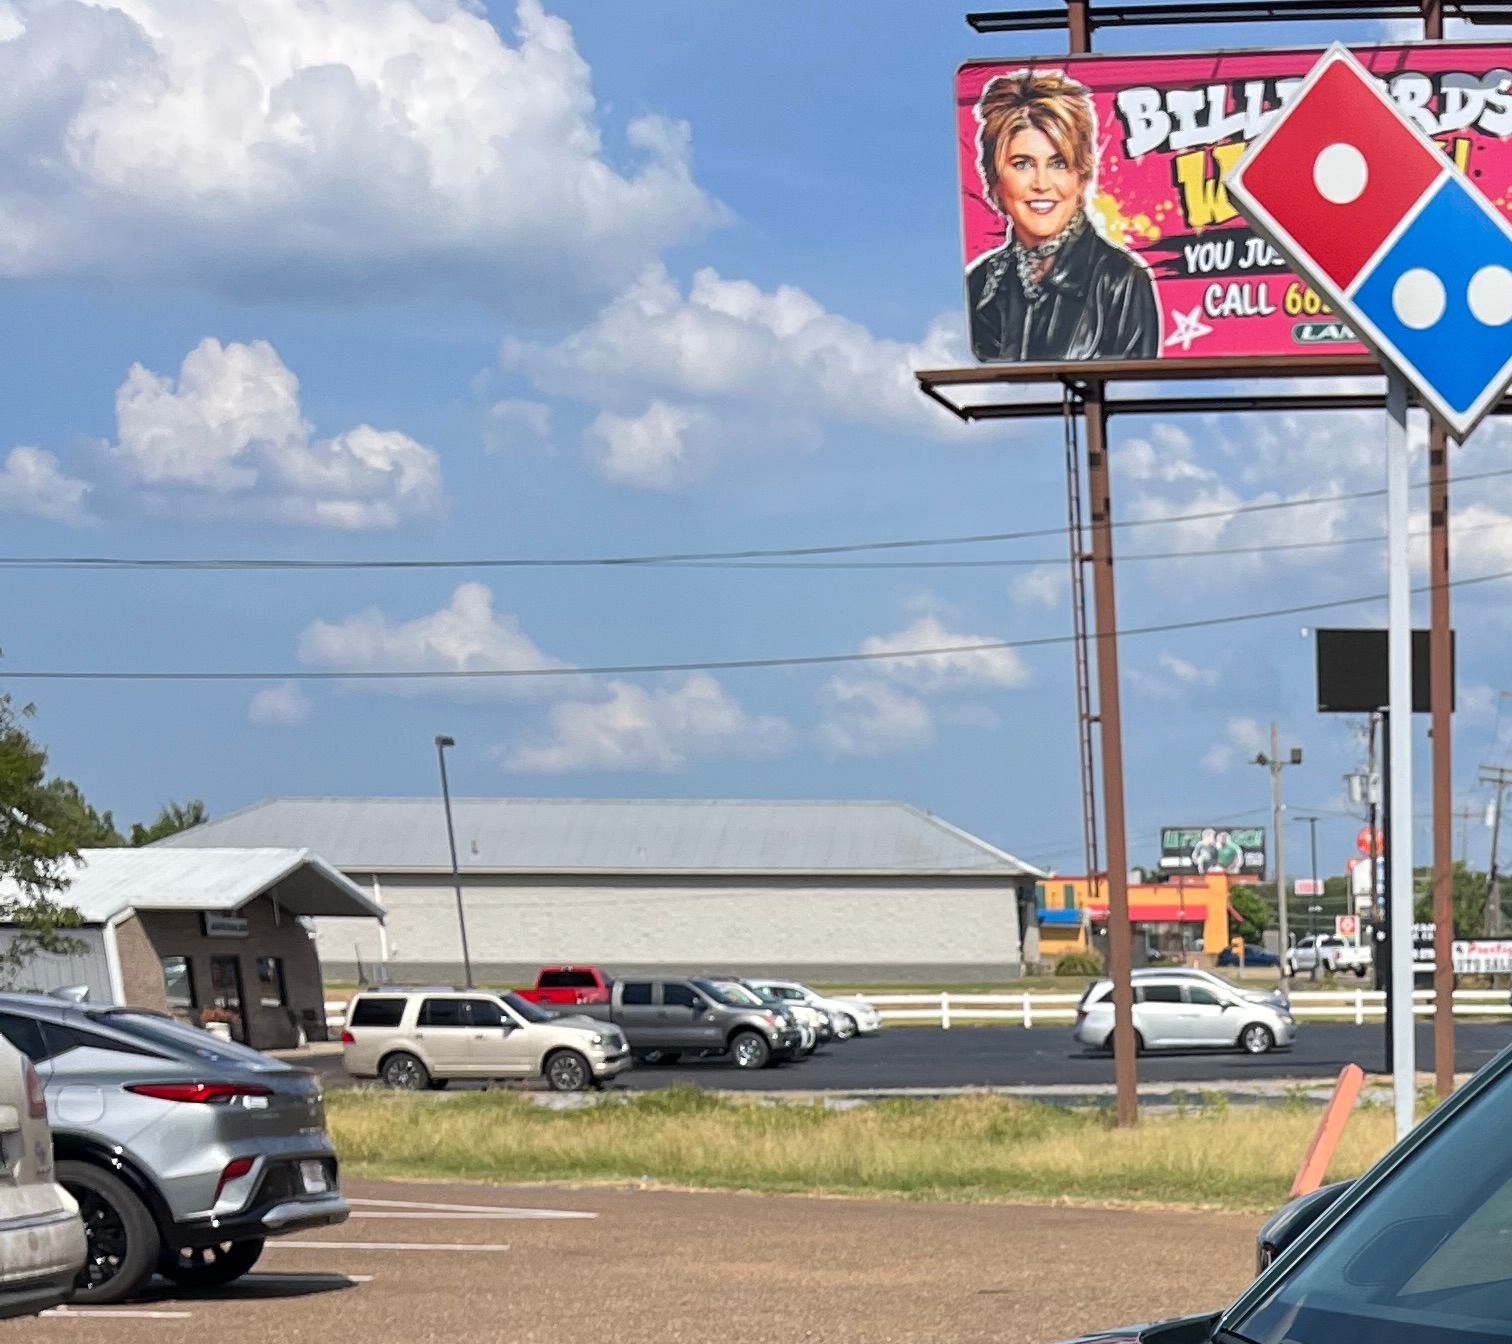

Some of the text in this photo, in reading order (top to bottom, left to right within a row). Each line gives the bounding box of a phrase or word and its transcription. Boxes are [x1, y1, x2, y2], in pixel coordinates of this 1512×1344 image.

[1184, 238, 1235, 274] YOU
[1204, 281, 1333, 317] CALL 66
